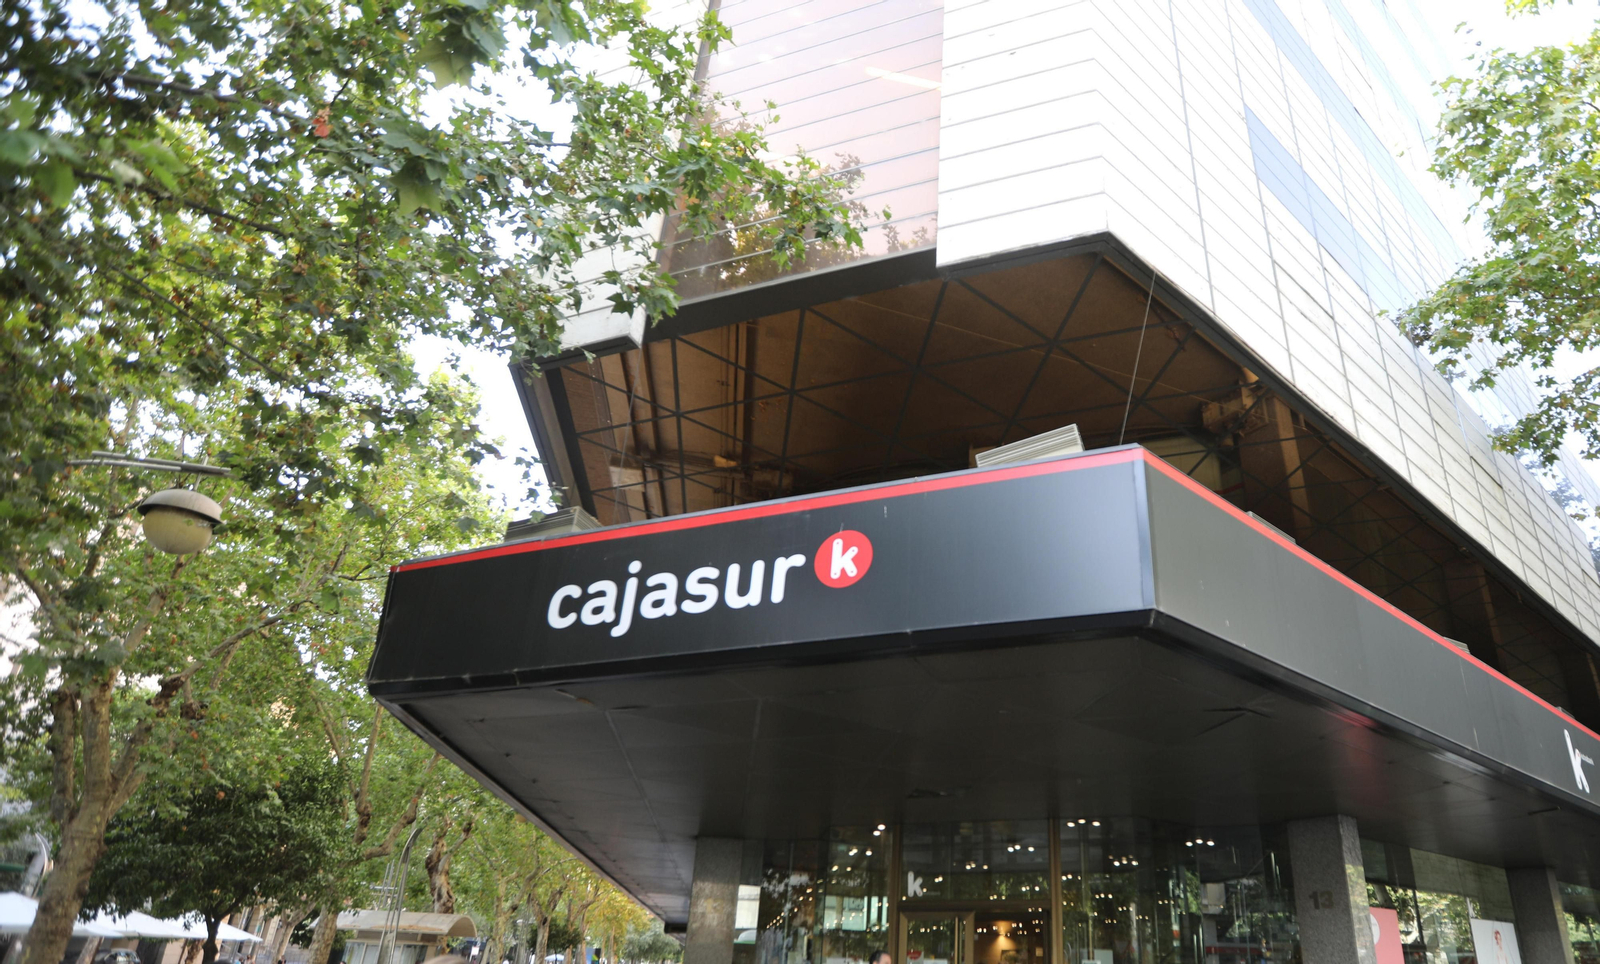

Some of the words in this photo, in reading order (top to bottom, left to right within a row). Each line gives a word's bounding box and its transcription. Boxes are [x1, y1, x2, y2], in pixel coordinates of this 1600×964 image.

[547, 553, 807, 637] cajasur
[830, 538, 858, 579] k
[1564, 729, 1590, 793] k
[908, 871, 923, 897] k
[1309, 891, 1334, 909] 13
